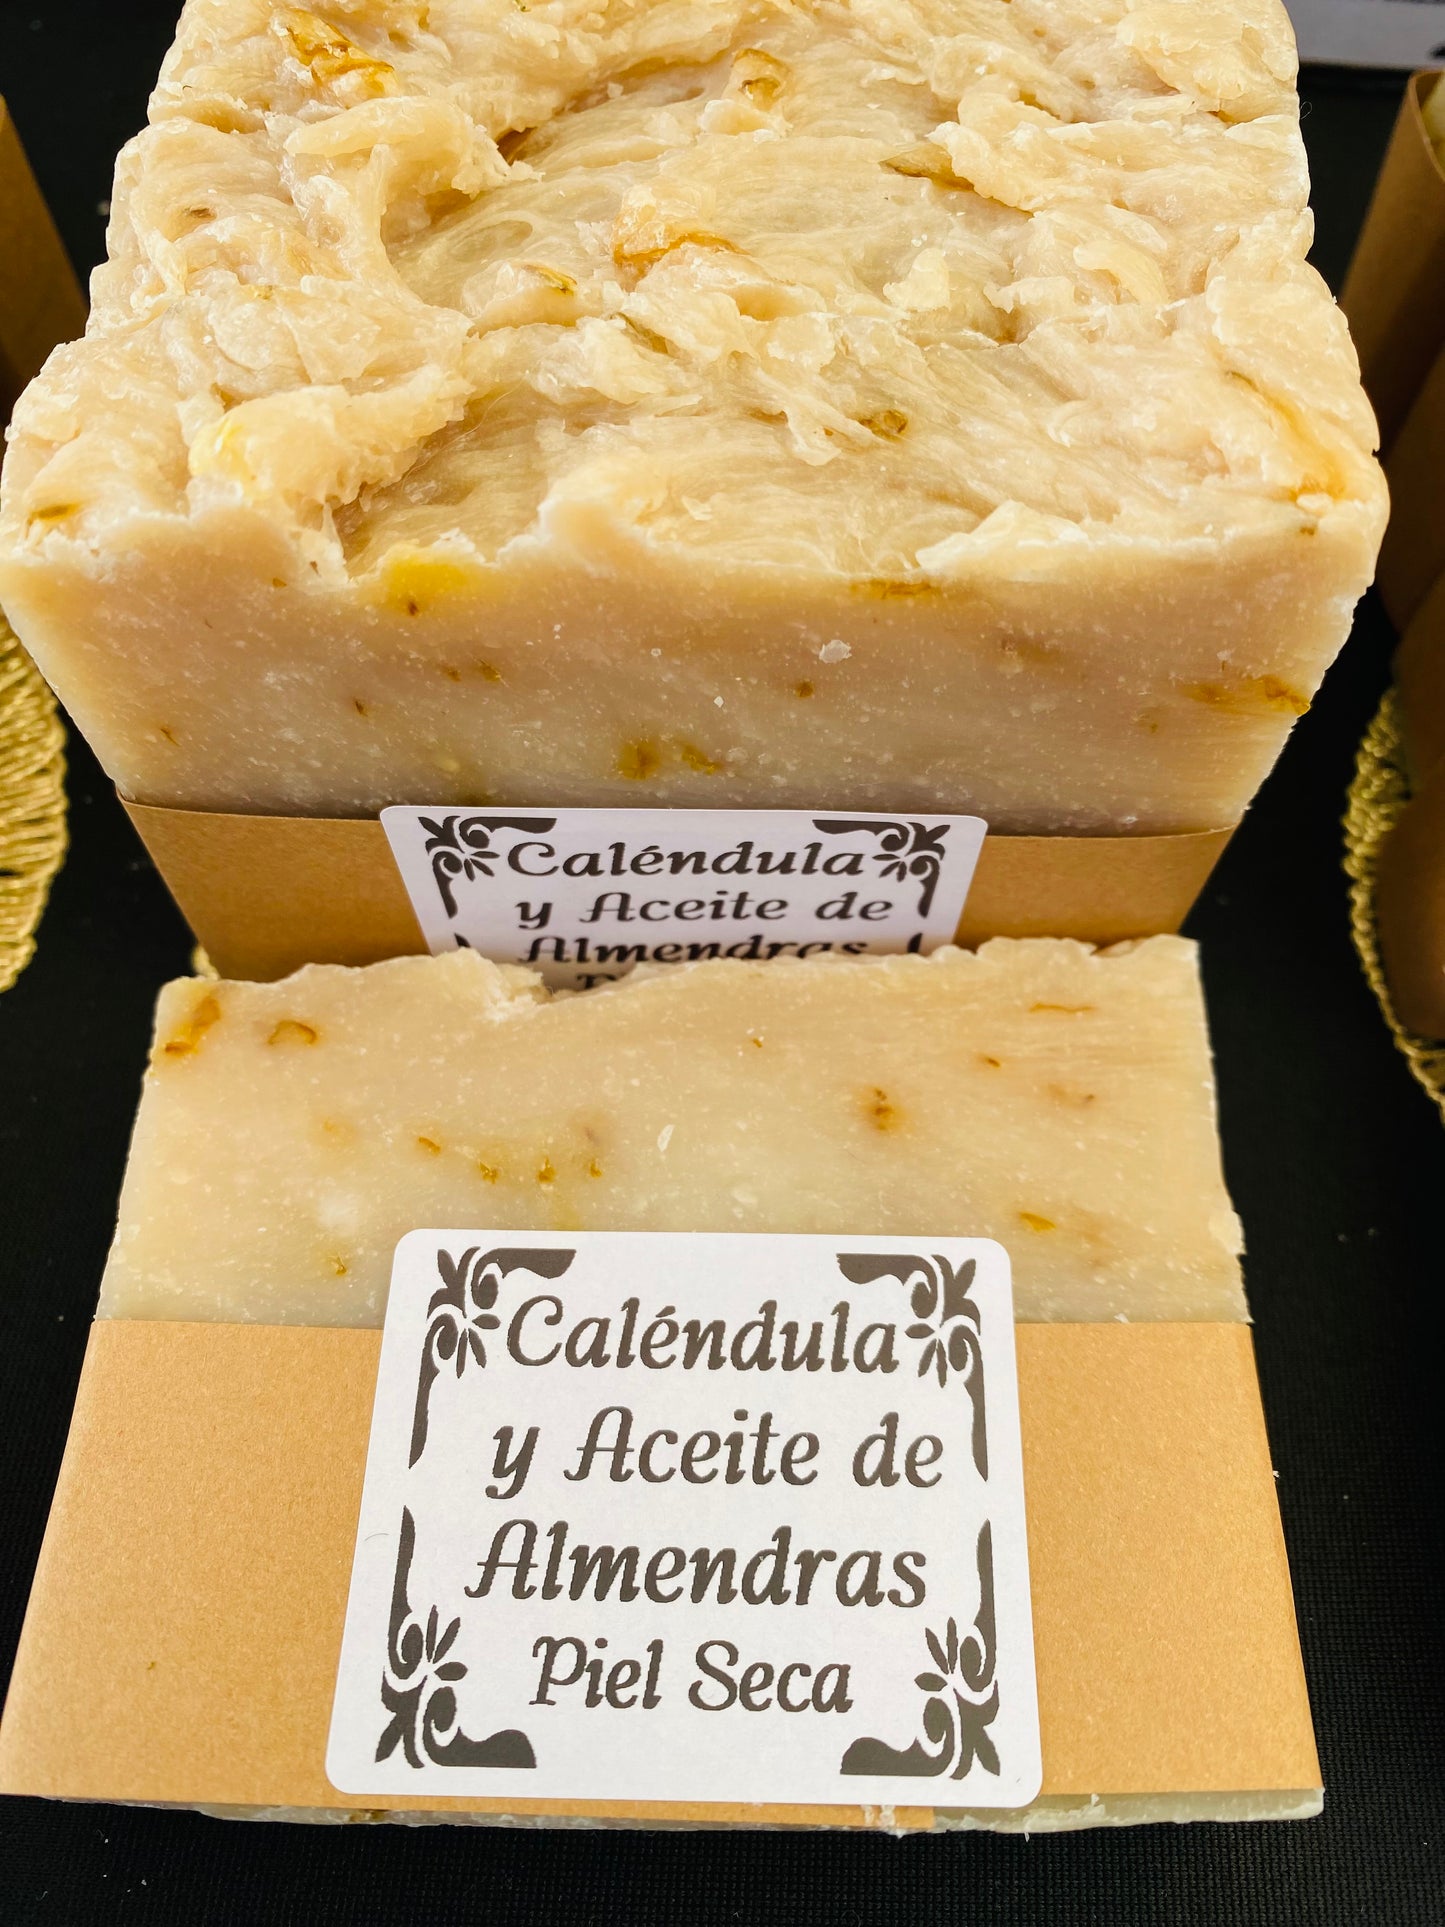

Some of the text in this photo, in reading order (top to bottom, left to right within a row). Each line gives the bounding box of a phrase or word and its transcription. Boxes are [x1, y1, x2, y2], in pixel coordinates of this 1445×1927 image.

[507, 840, 865, 878] Caléndula
[515, 890, 895, 930] y Aceite de
[507, 1295, 900, 1374] Caléndula
[485, 1406, 944, 1500] y Aceite de
[463, 1518, 927, 1608] Almendras
[528, 1635, 855, 1714] Piel Seca
